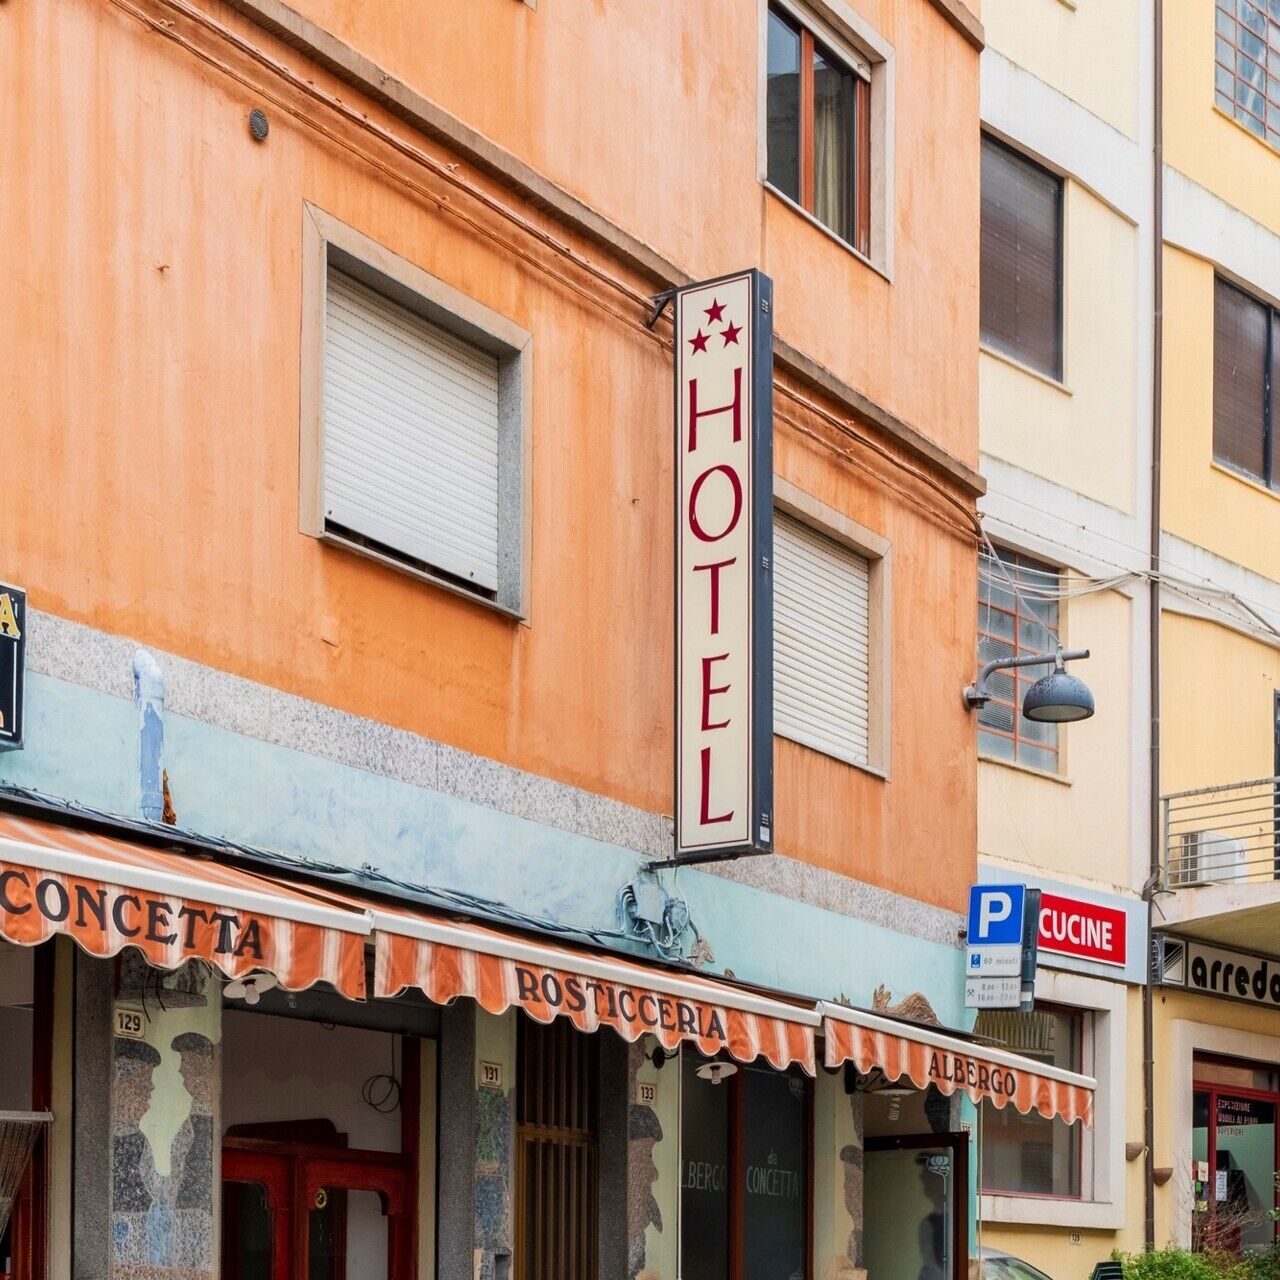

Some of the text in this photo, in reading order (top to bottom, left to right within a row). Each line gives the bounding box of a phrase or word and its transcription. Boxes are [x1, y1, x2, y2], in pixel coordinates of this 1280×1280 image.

[687, 367, 743, 826] HOTEL
[978, 892, 1012, 938] P
[1038, 908, 1113, 951] CUCINE
[118, 1013, 141, 1032] 129
[516, 966, 728, 1040] ROSTICCERIA
[484, 1066, 498, 1082] 131
[640, 1086, 654, 1100] 133
[927, 1050, 1017, 1099] ALBERGO
[680, 1161, 800, 1199] LBERGO CONCETTA
